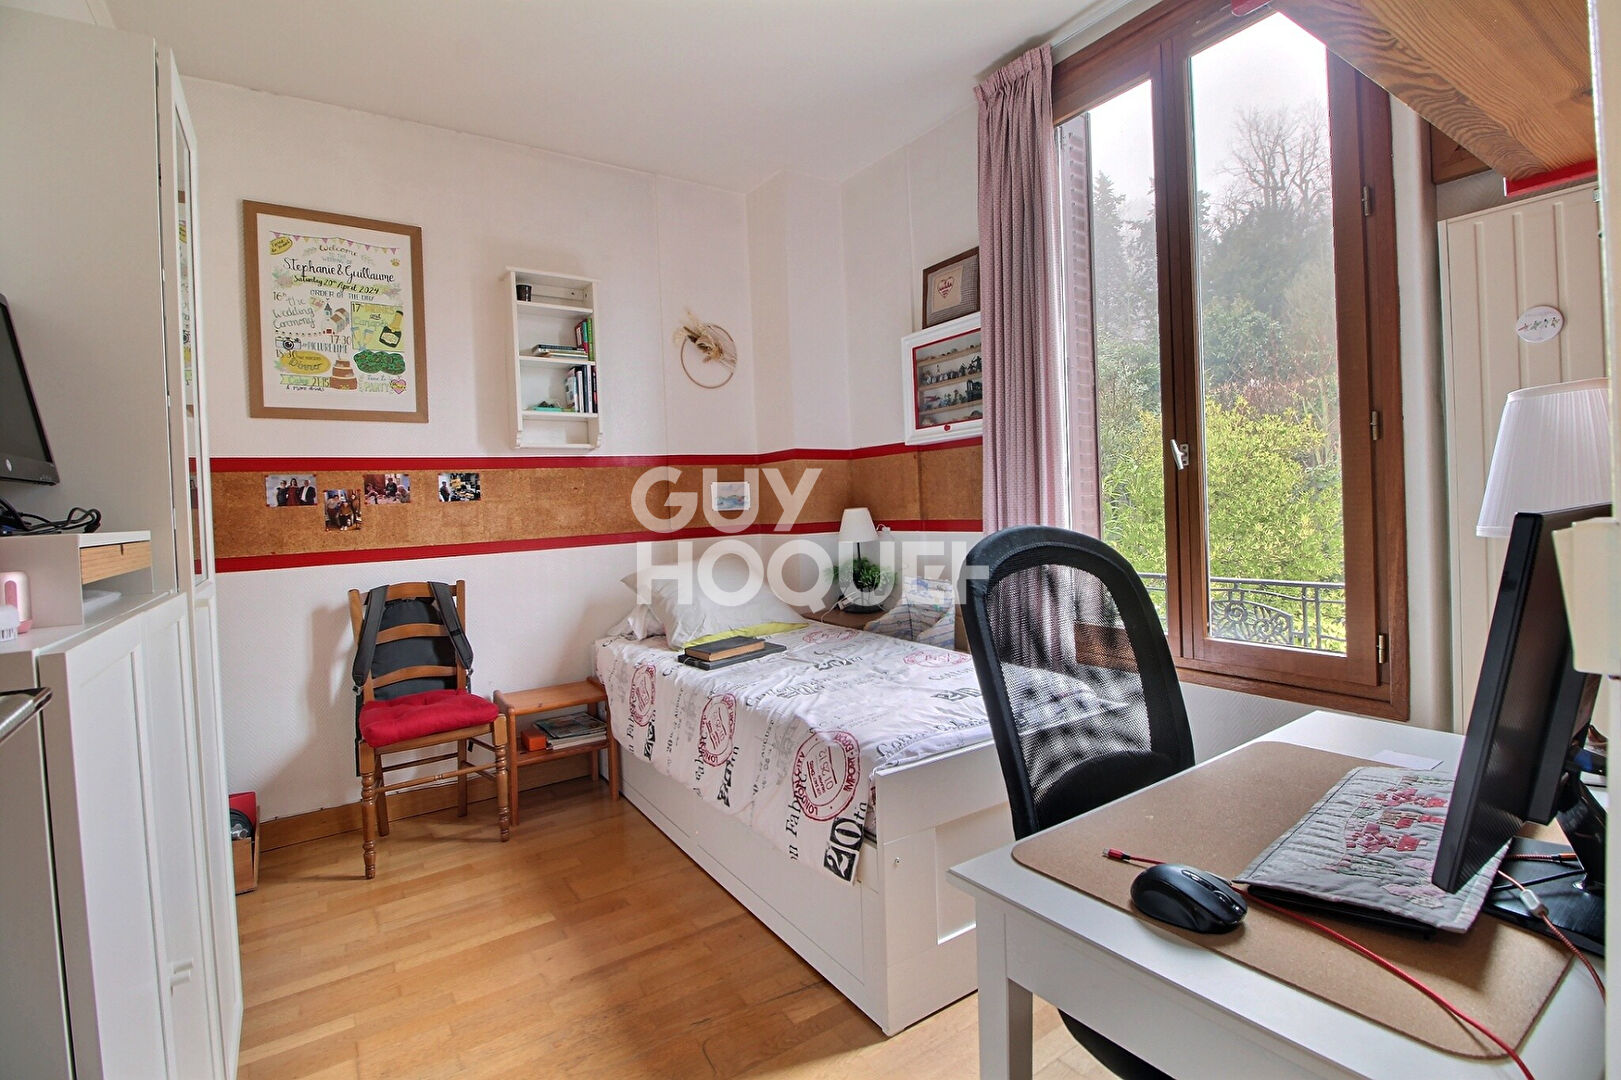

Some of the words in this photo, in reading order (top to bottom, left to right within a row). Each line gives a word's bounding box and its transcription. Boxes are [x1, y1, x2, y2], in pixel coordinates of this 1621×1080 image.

[283, 257, 335, 278] Stephanie
[336, 264, 343, 275] &
[344, 265, 395, 284] Guillaume
[359, 286, 380, 295] 2024
[785, 773, 807, 838] Fabric
[823, 801, 867, 883] 20th
